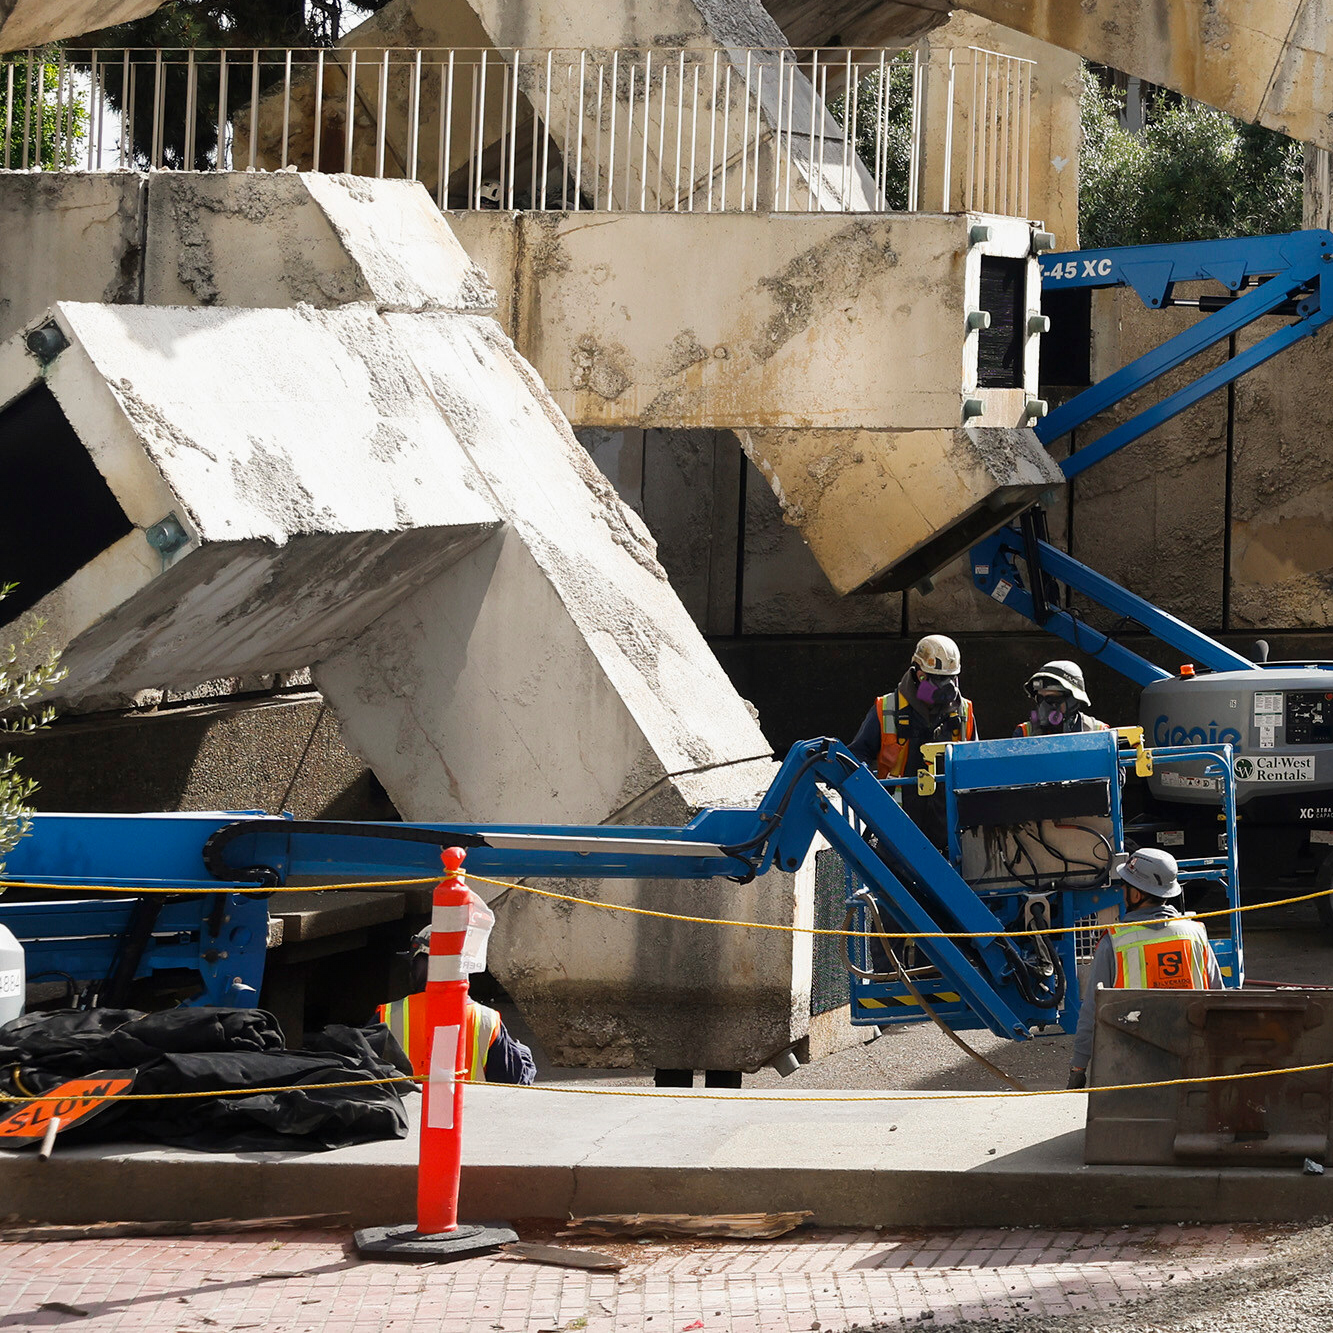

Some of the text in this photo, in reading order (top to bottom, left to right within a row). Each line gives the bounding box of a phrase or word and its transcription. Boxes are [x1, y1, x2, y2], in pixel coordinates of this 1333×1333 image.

[1081, 258, 1112, 278] XC
[1257, 769, 1307, 781] Rentals
[1299, 808, 1315, 819] XC
[4, 1080, 114, 1134] SLOW
